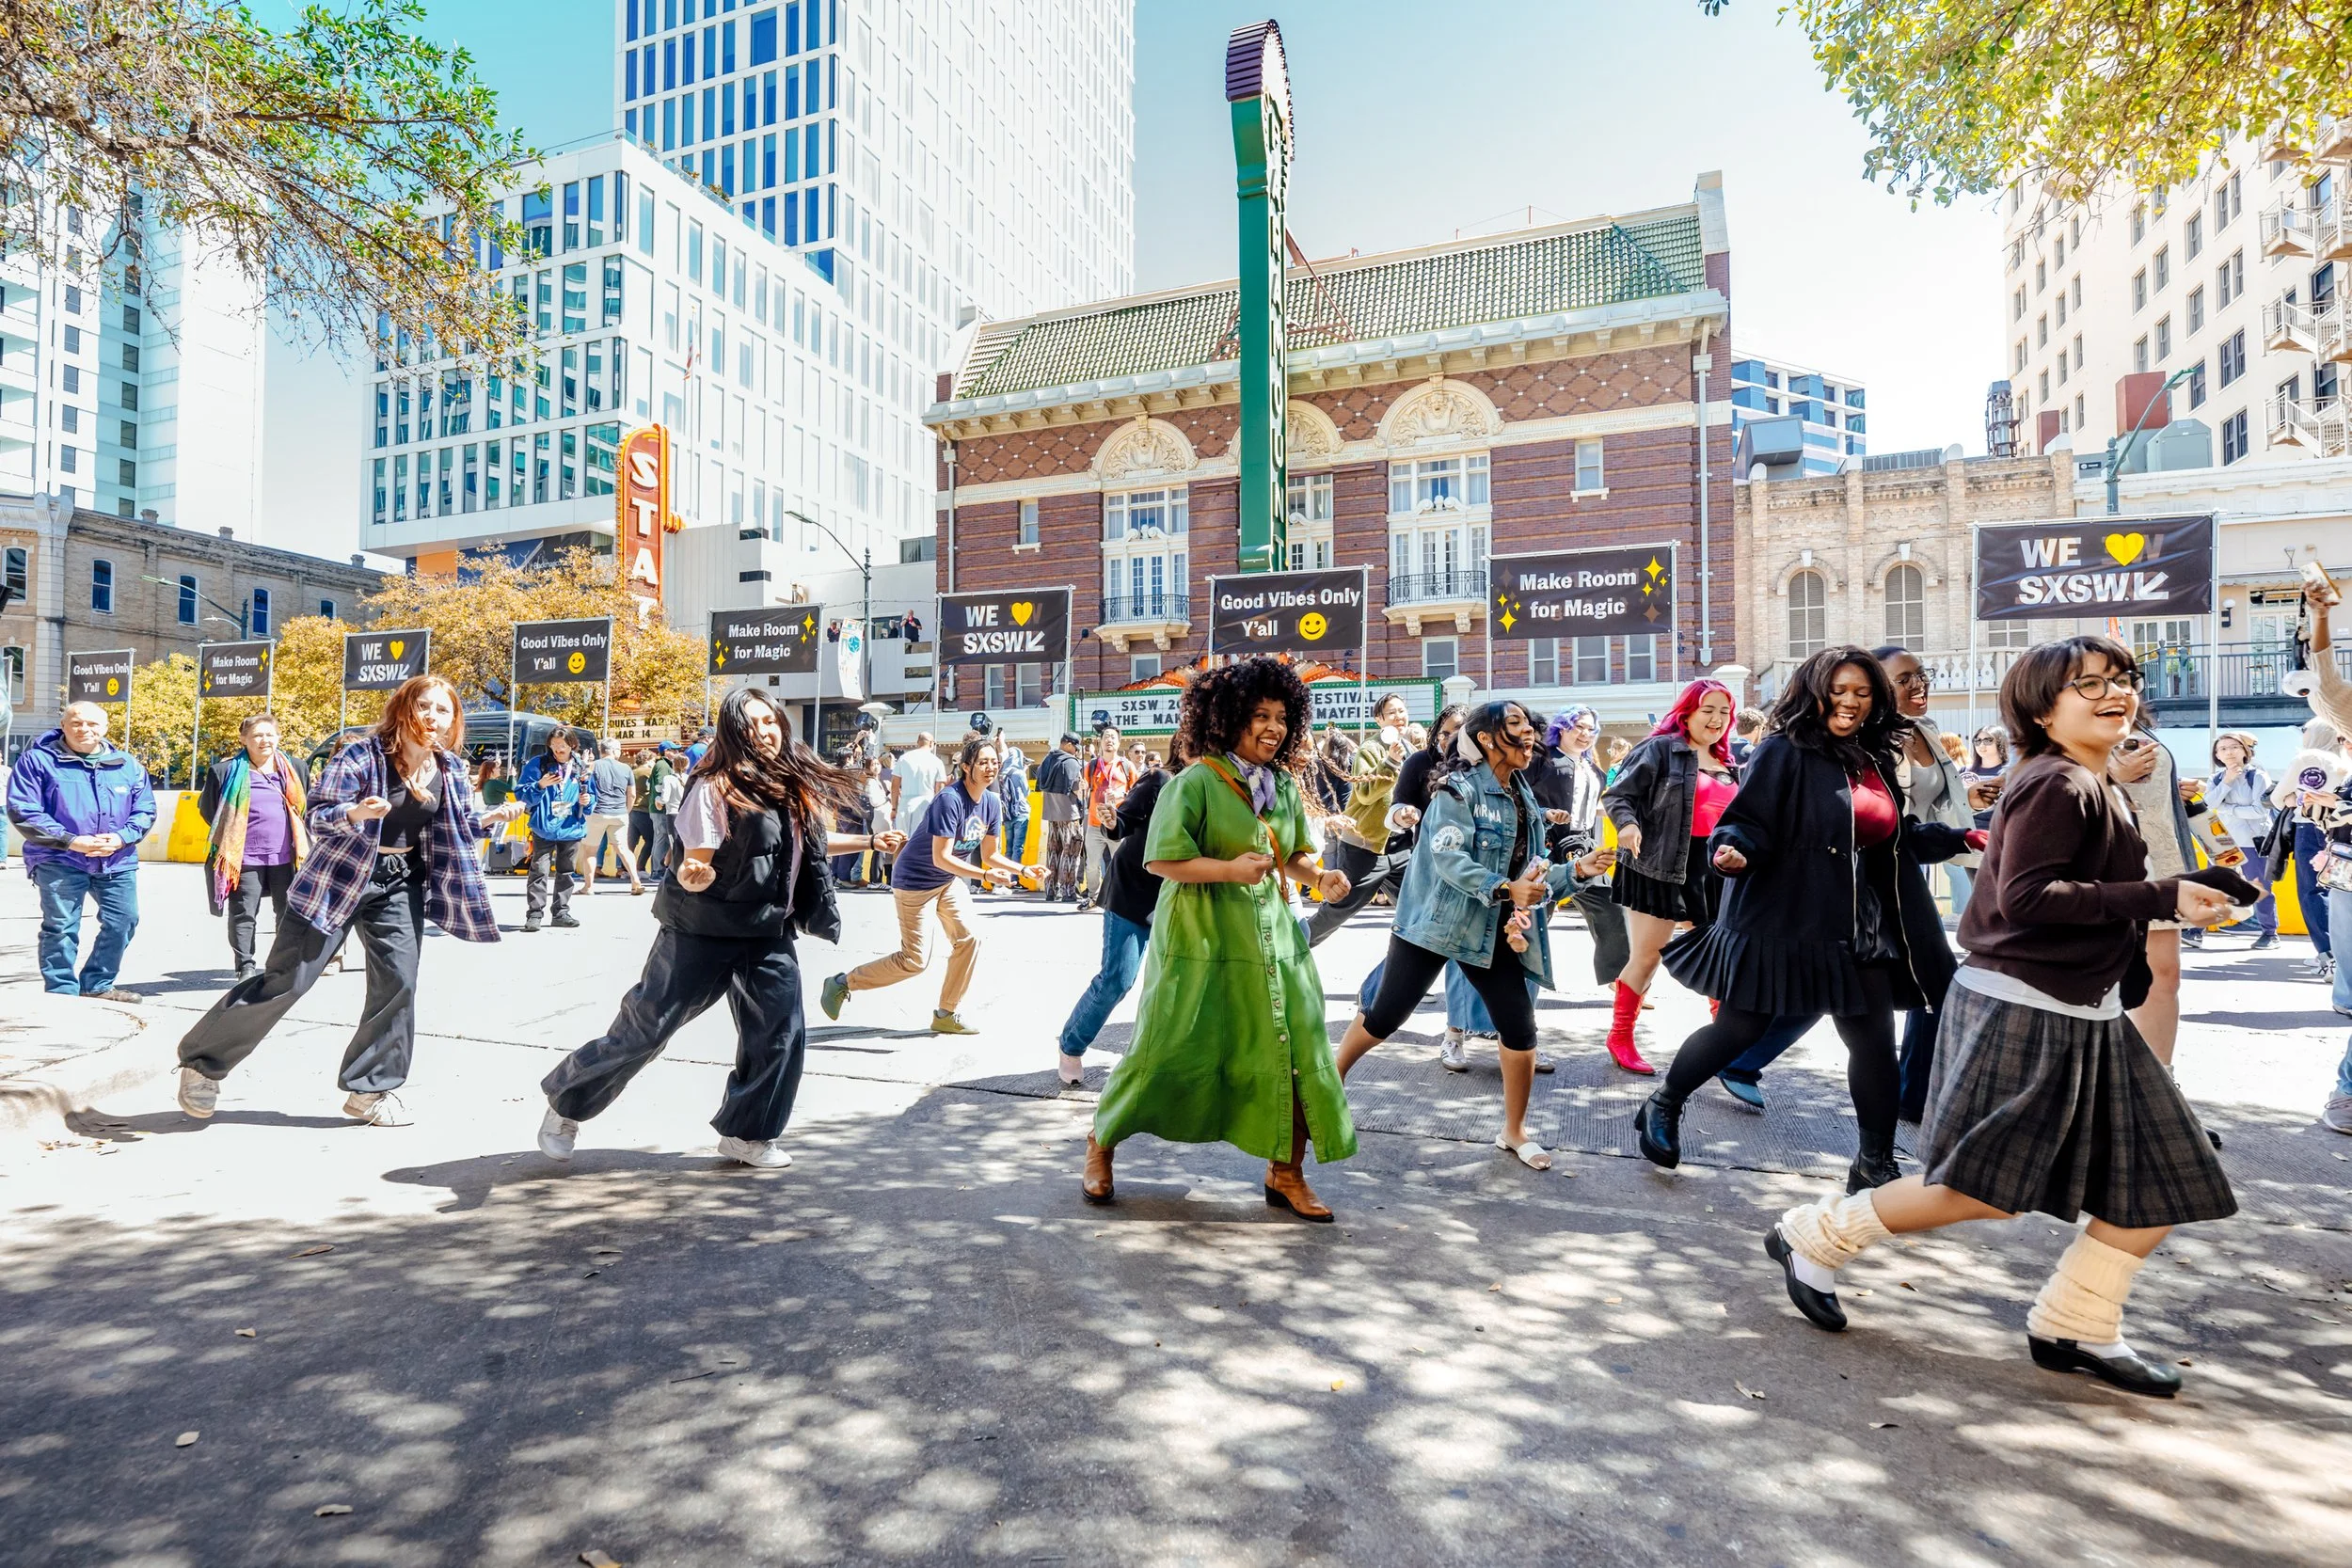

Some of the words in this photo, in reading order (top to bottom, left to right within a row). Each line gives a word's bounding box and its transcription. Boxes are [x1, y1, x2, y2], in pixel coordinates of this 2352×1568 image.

[2019, 536, 2082, 568] WE
[1519, 573, 1572, 592] Make
[1578, 570, 1637, 588] Room
[1220, 593, 1263, 610] Good
[1268, 591, 1316, 608] Vibes
[1320, 587, 1361, 607] Only
[965, 604, 999, 627] WE
[1530, 601, 1560, 619] for
[1564, 597, 1626, 619] Magic
[728, 624, 761, 638] Make
[763, 623, 799, 637] Room
[520, 636, 548, 649] Good
[550, 634, 580, 648] Vibes
[581, 633, 608, 649] Only
[360, 642, 383, 661] WE
[734, 645, 753, 659] for
[754, 643, 791, 660] Magic
[73, 663, 93, 675] Good
[94, 662, 114, 674] Vibes
[212, 657, 234, 668] Make
[235, 656, 259, 667] Room
[215, 673, 229, 685] for
[229, 673, 253, 687] Magic
[1121, 699, 1158, 712] SXSW
[1115, 714, 1138, 726] THE
[642, 729, 651, 738] 14
